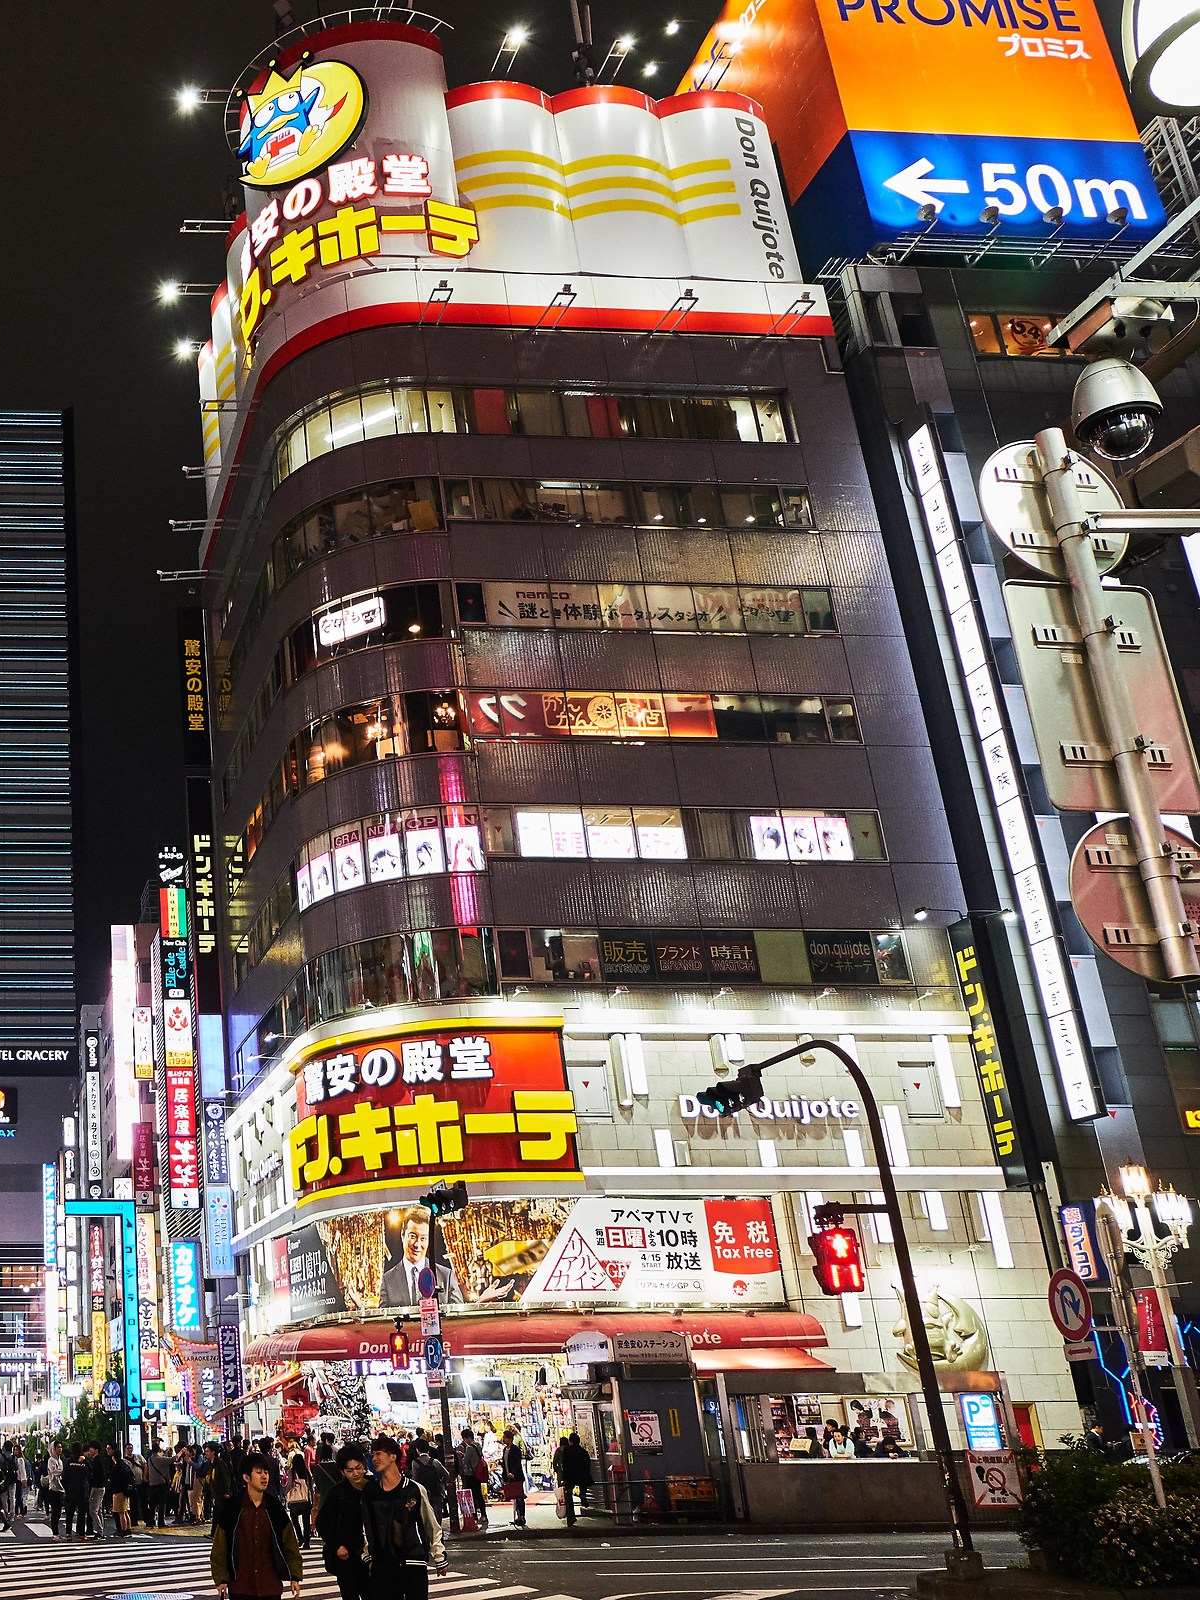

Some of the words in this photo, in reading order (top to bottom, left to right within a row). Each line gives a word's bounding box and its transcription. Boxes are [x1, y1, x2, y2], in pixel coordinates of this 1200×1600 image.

[836, 0, 1081, 32] PROMISE
[997, 34, 1092, 60] プロミス
[735, 116, 761, 169] Don
[749, 177, 786, 280] Quijote
[981, 163, 1148, 221] 50m
[240, 153, 433, 290] 安の殿堂
[515, 589, 570, 600] namco
[183, 638, 206, 732] 驚安の殿堂
[193, 833, 216, 954] ドン・キホーテ
[603, 941, 648, 963] 販売
[656, 945, 701, 960] ブランド
[710, 945, 753, 960] 時計
[711, 959, 756, 971] WATCH
[16, 1049, 70, 1061] GRACERY
[955, 945, 1016, 1156] ドン・キホーテ
[302, 1036, 496, 1105] 驚安の殿堂
[173, 1087, 191, 1135] 居楽屋
[751, 1095, 861, 1125] Quijote
[610, 1208, 695, 1224] アベマTVで
[607, 1228, 645, 1248] 日曜
[657, 1229, 699, 1248] 10時
[712, 1220, 770, 1245] 免税
[665, 1251, 702, 1271] 放送
[714, 1246, 742, 1259] Tax
[743, 1246, 774, 1259] Free
[173, 1244, 195, 1325] カラオケ
[358, 1341, 390, 1355] Don
[616, 1339, 682, 1349] 安全安心ステーション
[222, 1330, 238, 1394] カラオケ
